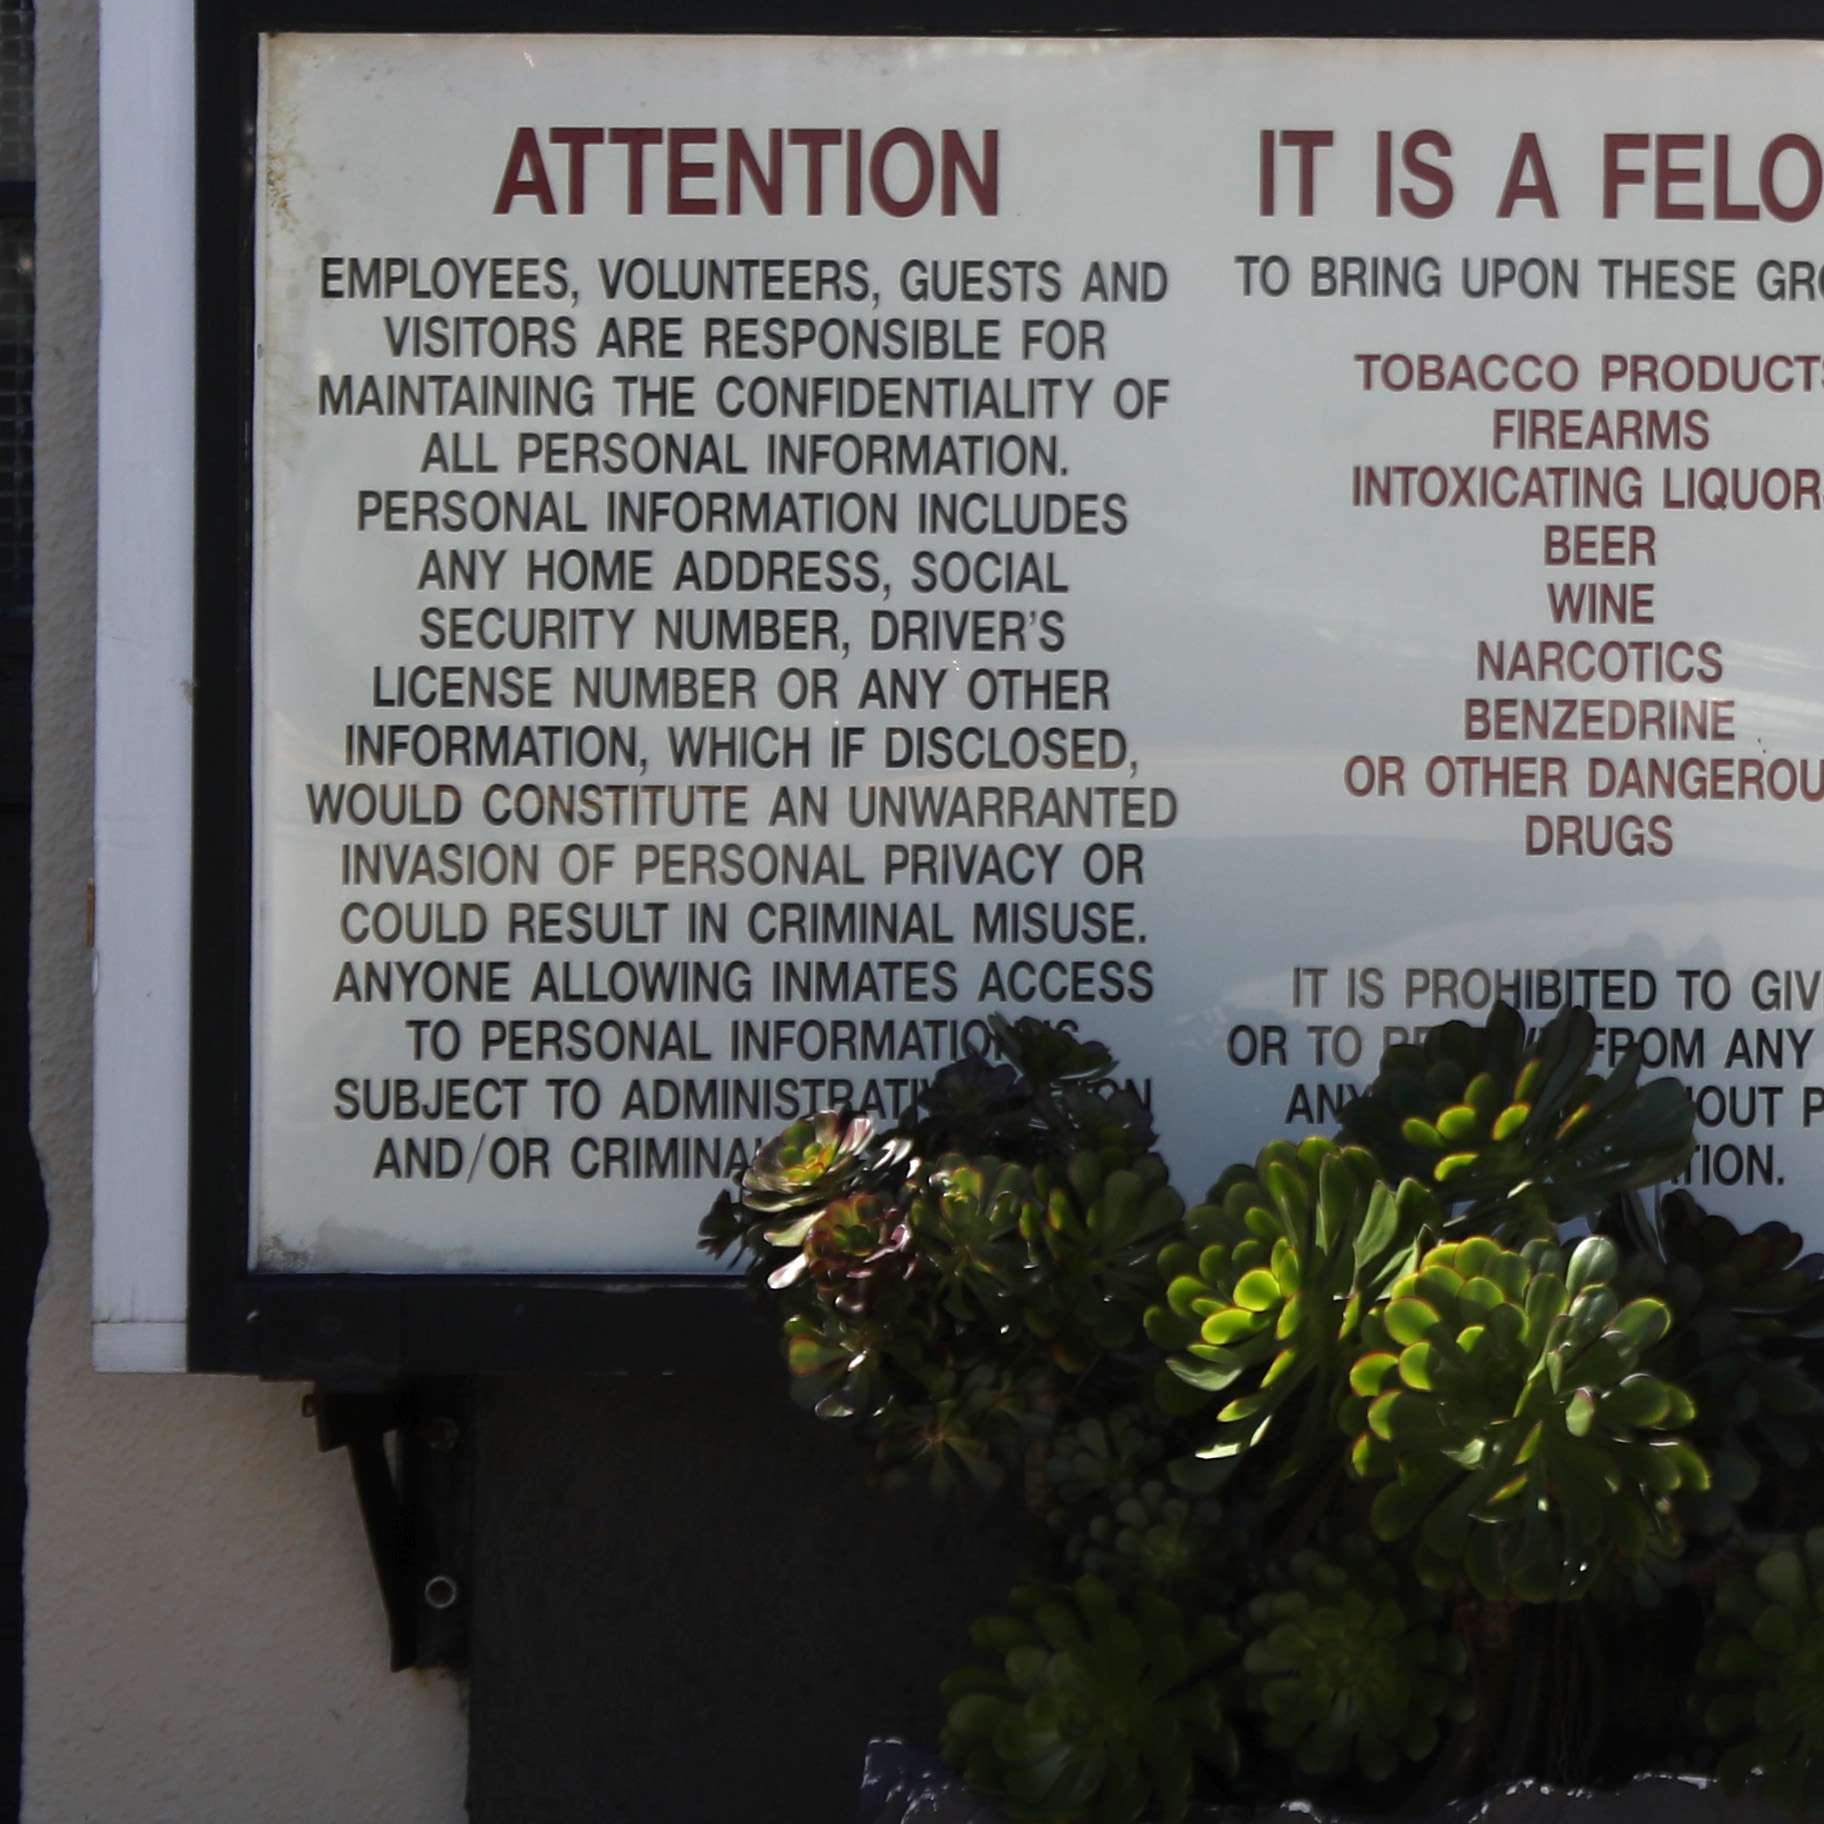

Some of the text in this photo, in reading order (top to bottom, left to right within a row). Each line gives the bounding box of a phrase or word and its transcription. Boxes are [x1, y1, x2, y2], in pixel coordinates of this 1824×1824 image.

[494, 127, 998, 217] ATTENTION
[1260, 130, 1333, 216] IT
[1377, 129, 1454, 219] IS
[1497, 132, 1558, 218] A
[322, 257, 1167, 308] EMPLOYEES, VOLUNTEERS, GUESTS AND
[1235, 255, 1289, 296] TO
[1312, 256, 1440, 297] BRING
[1463, 258, 1578, 298] UPON
[1599, 259, 1735, 300] THESE
[384, 316, 1104, 360] VISITORS ARE RESPONSIBLE FOR
[1355, 354, 1578, 392] TOBACCO
[320, 375, 1169, 419] MAINTAINING THE CONFIDENTIALITY OF
[1494, 409, 1709, 450] FIREARMS
[421, 432, 1067, 476] ALL PERSONAL INFORMATION.
[1353, 466, 1642, 509] INTOXICATING
[359, 490, 1127, 535] PERSONAL INFORMATION INCLUDES
[1545, 525, 1656, 566] BEER
[418, 549, 1068, 600] ANY HOME ADDRESS, SOCIAL
[1547, 583, 1654, 624] WINE
[421, 607, 635, 649] SECURITY
[657, 609, 849, 658] NUMBER,
[1478, 640, 1723, 683] NARCOTICS
[374, 666, 1108, 710] LICENSE NUMBER OR ANY OTHER
[1466, 698, 1735, 740] BENZEDRINE
[346, 724, 1136, 777] INFORMATION, WHICH IF DISCLOSED,
[1345, 755, 1404, 796] OR
[1426, 756, 1567, 797] OTHER
[306, 783, 1177, 828] WOULD CONSTITUTE AN UNWARRANTED
[1527, 815, 1673, 857] DRUGS
[343, 843, 1143, 885] INVASION OF PERSONAL PRIVACY OR
[341, 902, 1146, 944] COULD RESULT IN CRIMINAL MISUSE.
[333, 960, 1153, 1002] ANYONE ALLOWING INMATES ACCESS
[1294, 967, 1328, 1007] IT
[1349, 968, 1384, 1008] IS
[1406, 968, 1657, 1010] PROHIBITED
[1676, 969, 1731, 1011] TO
[406, 1019, 460, 1061] TO
[483, 1019, 711, 1061] PERSONAL
[1228, 1024, 1287, 1066] OR
[1307, 1026, 1361, 1066] TO
[1724, 1028, 1814, 1069] ANY
[335, 1078, 601, 1120] SUBJECT TO
[374, 1134, 549, 1179] AND/OR
